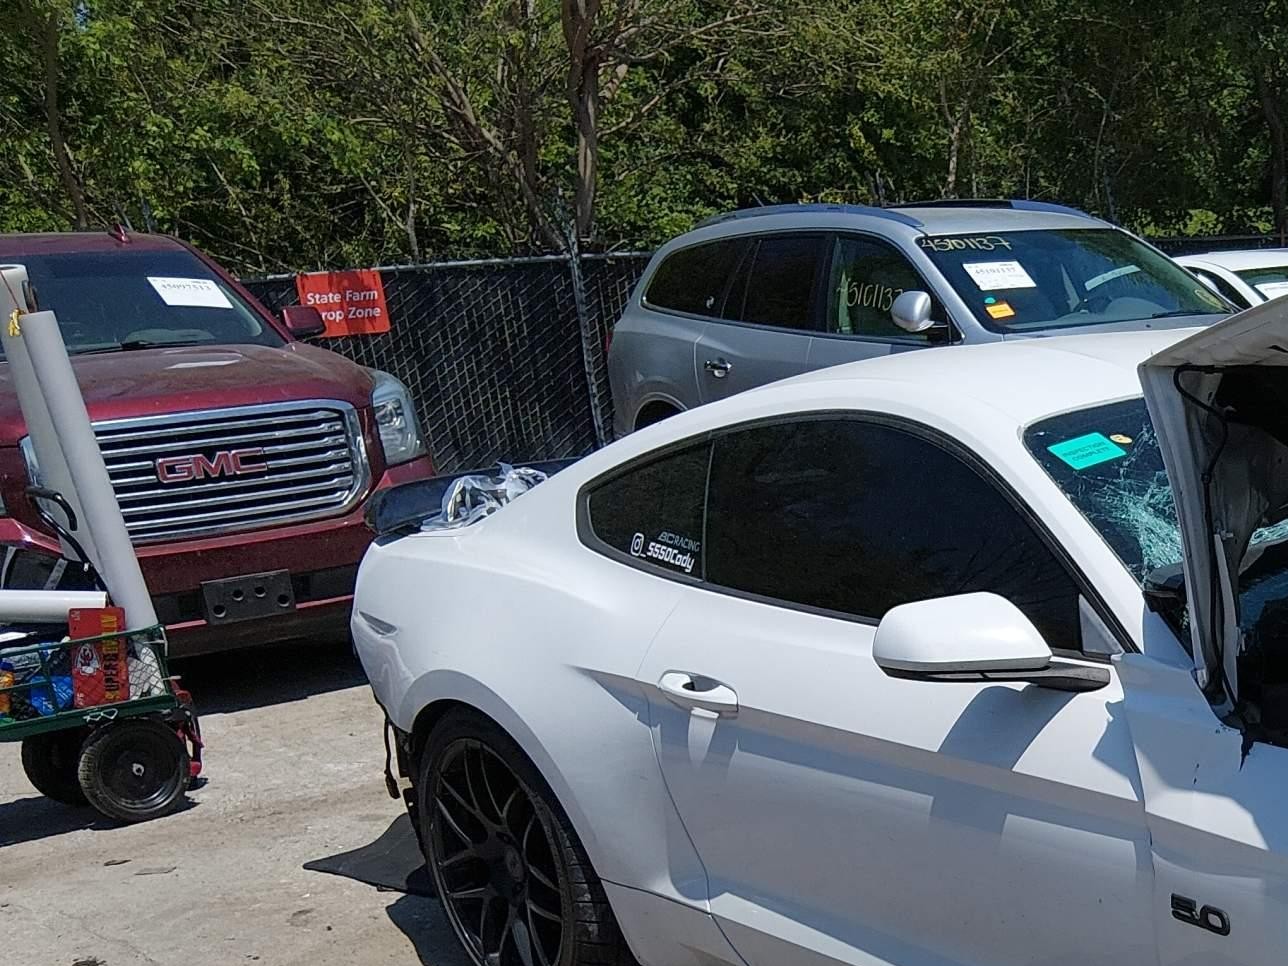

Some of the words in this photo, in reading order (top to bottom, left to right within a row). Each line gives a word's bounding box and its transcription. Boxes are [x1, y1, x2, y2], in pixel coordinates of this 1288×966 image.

[921, 236, 1013, 251] 45101137
[306, 292, 342, 305] State
[345, 290, 378, 302] Farm
[320, 310, 345, 323] rop
[348, 307, 381, 319] Zone
[156, 447, 268, 484] GMC
[1171, 893, 1230, 936] 5.0
